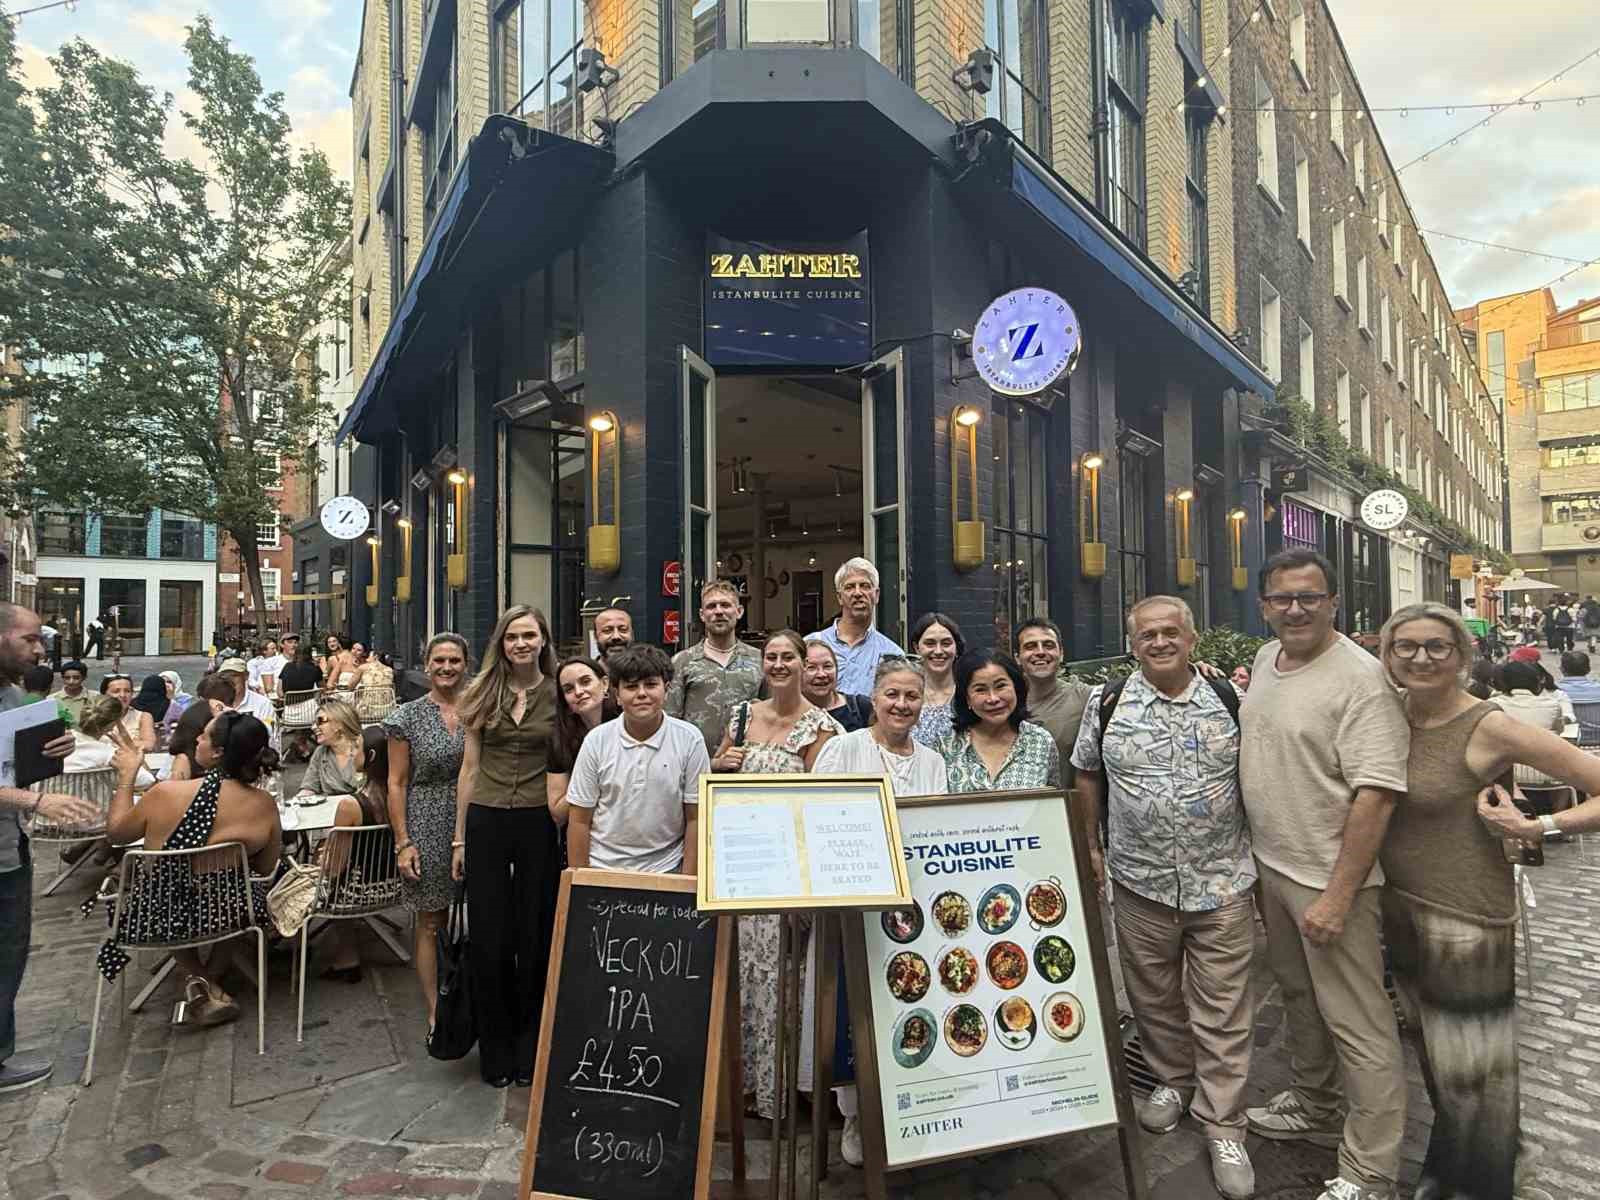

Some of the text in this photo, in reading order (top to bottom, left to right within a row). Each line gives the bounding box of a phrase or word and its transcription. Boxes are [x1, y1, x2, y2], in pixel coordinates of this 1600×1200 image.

[711, 254, 862, 278] ZAHTER
[712, 290, 862, 299] ISTANBULITE CUISINE
[981, 293, 1065, 328] ZAHTER
[1008, 323, 1044, 361] Z
[1374, 503, 1393, 515] SL
[904, 836, 1042, 860] STANBULITE
[924, 855, 1015, 876] CUISINE
[660, 938, 700, 979] OIL
[608, 985, 654, 1032] IPA
[569, 1038, 662, 1090] £4.50
[899, 1116, 964, 1139] ZAHTER
